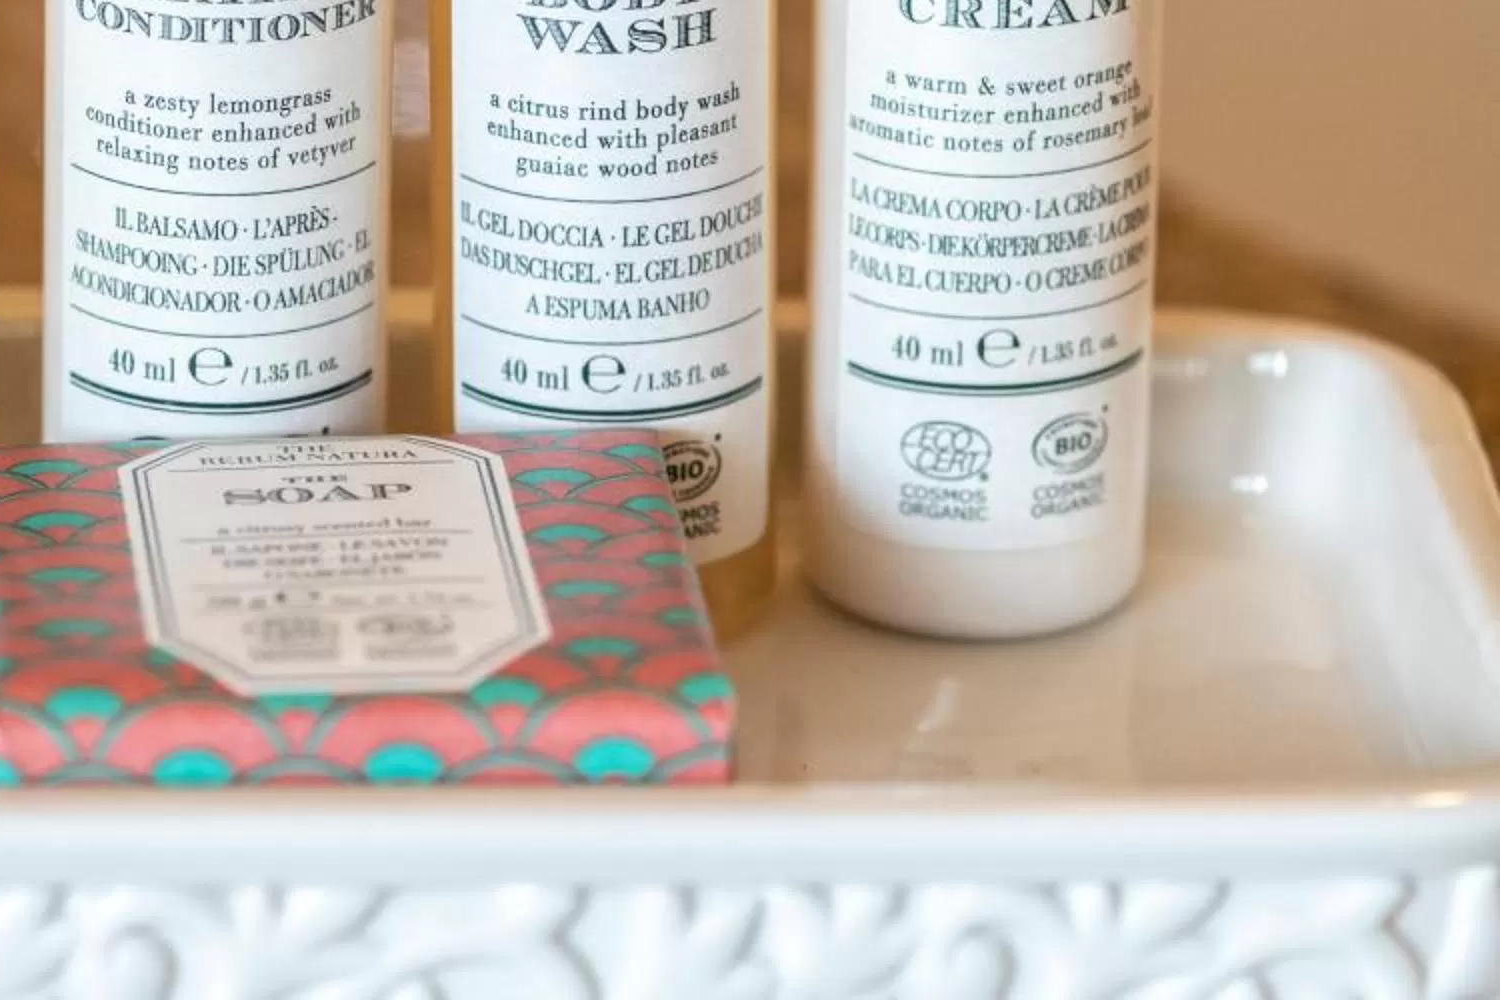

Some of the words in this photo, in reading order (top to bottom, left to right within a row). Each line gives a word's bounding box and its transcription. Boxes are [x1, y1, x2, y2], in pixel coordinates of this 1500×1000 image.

[516, 7, 717, 55] WASH
[886, 70, 896, 84] a
[905, 73, 967, 95] warm
[978, 77, 996, 96] &
[1005, 77, 1066, 95] sweet
[1074, 60, 1132, 88] orange
[125, 90, 135, 104] a
[144, 94, 200, 118] zesty
[209, 88, 331, 116] lemongrass
[490, 93, 499, 108] a
[508, 94, 569, 118] citrus
[579, 100, 626, 121] rind
[636, 96, 689, 121] body
[697, 81, 740, 109] wash
[871, 93, 995, 124] moisturizer
[1004, 93, 1103, 125] enhanced
[1110, 80, 1141, 105] with
[86, 106, 202, 142] conditioner
[211, 115, 317, 142] enhanced
[325, 100, 361, 129] with
[487, 120, 587, 149] enhanced
[598, 128, 647, 149] with
[657, 114, 737, 152] pleasant
[943, 136, 1003, 152] notes
[1013, 131, 1037, 151] of
[1043, 116, 1127, 150] rosemary
[97, 136, 178, 174] relaxing
[189, 154, 249, 171] notes
[258, 149, 280, 168] of
[288, 136, 356, 166] vetyver
[516, 156, 588, 177] guaiac
[598, 155, 657, 177] wood
[666, 151, 719, 173] notes
[873, 188, 941, 219] CREMA
[945, 200, 1021, 222] CORPO
[1035, 199, 1060, 220] LA
[137, 215, 237, 241] BALSAMO
[478, 211, 514, 237] GEL
[518, 218, 603, 248] DOCCIA
[623, 225, 650, 248] LE
[655, 220, 695, 245] GEL
[75, 229, 198, 276] SHAMPOOING
[213, 256, 250, 277] DIE
[255, 239, 344, 275] SPÜLUNG
[492, 249, 601, 284] DUSCHGEL
[614, 262, 640, 284] EL
[645, 258, 686, 282] GEL
[898, 264, 922, 289] EL
[925, 270, 1011, 294] CUERPO
[1025, 271, 1042, 292] O
[254, 290, 270, 311] O
[545, 296, 631, 320] ESPUMA
[638, 288, 711, 320] BANHO
[109, 348, 135, 374] 40
[145, 358, 176, 383] ml
[253, 363, 289, 385] 1.35
[501, 358, 527, 385] 40
[537, 366, 569, 391] ml
[648, 370, 682, 391] 1.35
[307, 449, 419, 462] NATURA
[1055, 432, 1092, 455] BIO
[223, 482, 412, 505] SOAP
